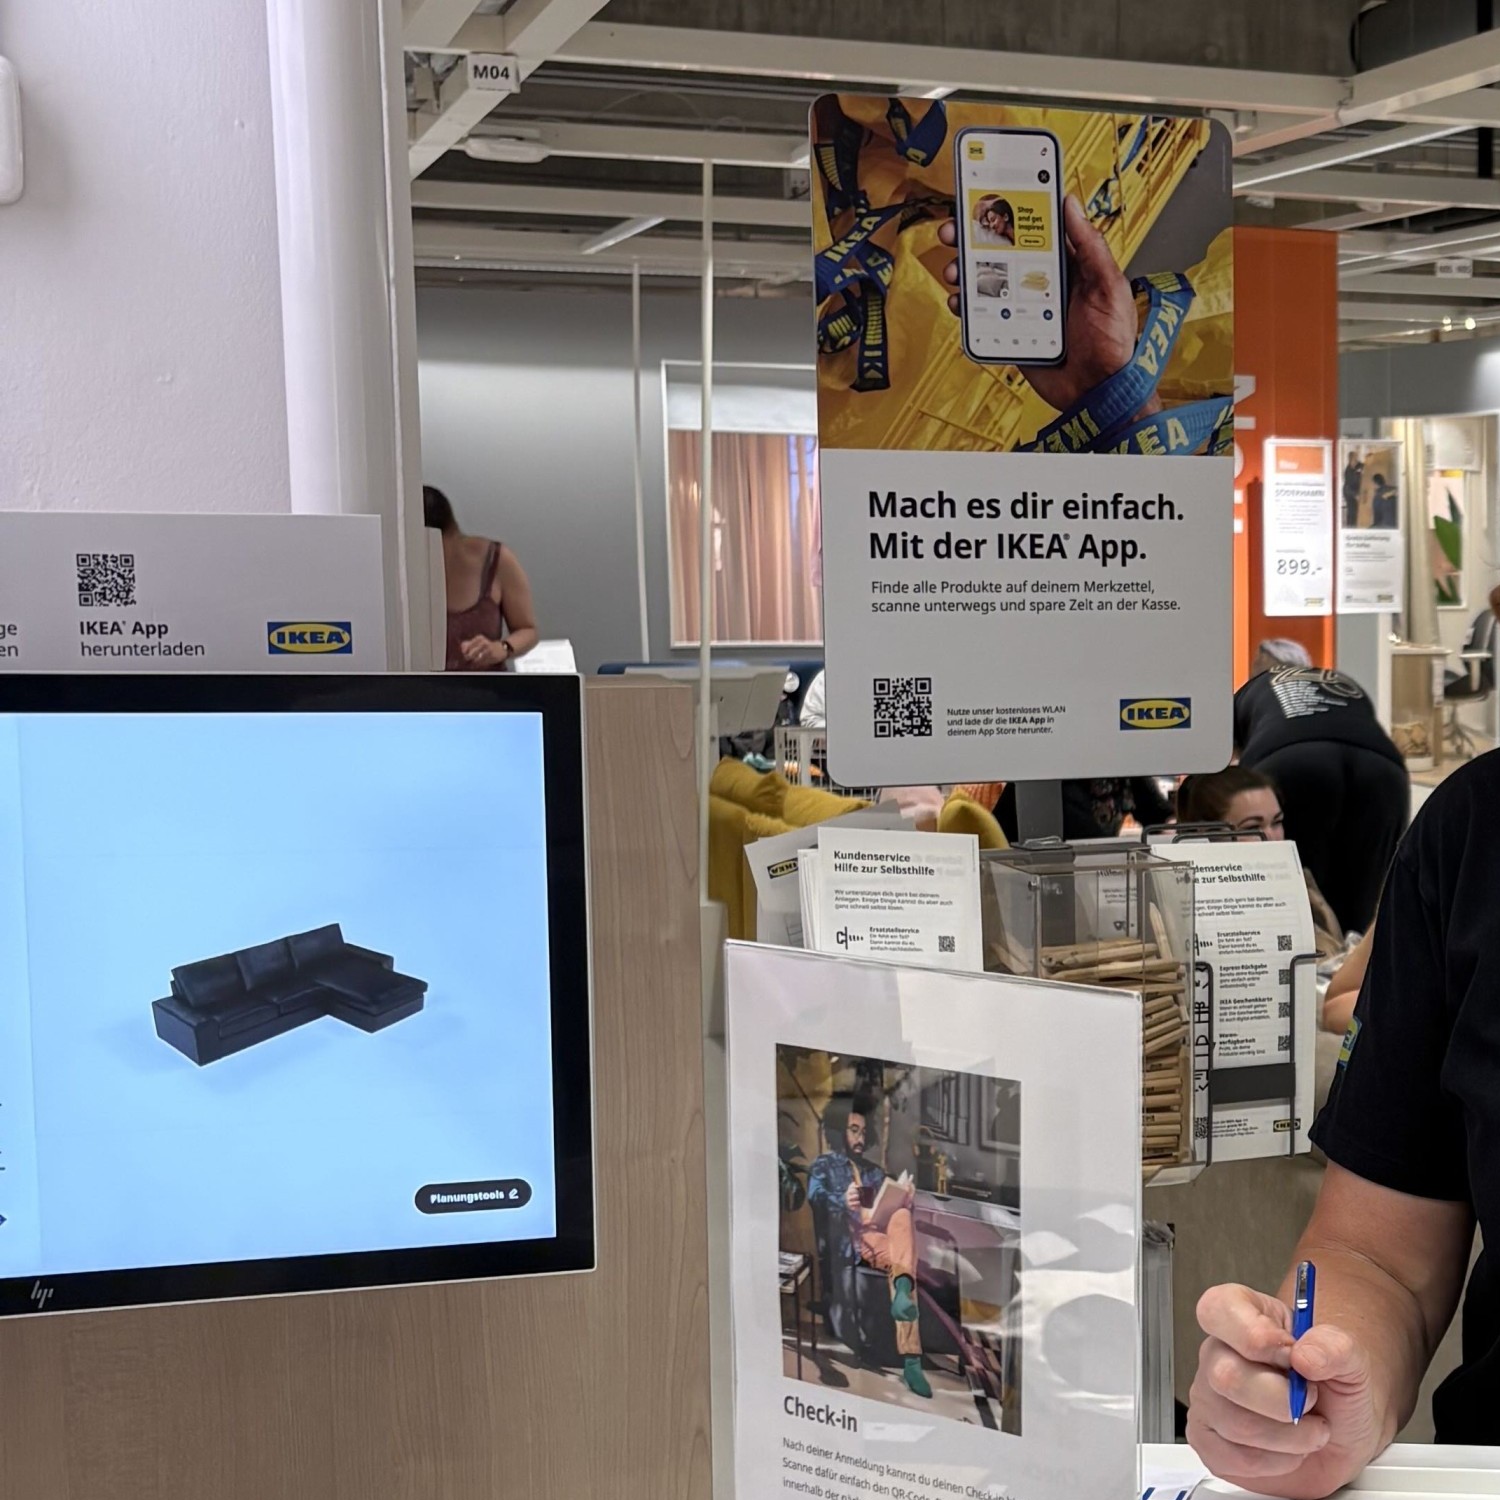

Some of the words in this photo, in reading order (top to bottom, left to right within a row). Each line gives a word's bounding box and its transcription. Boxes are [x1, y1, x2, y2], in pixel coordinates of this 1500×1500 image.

[473, 64, 510, 79] M04
[825, 215, 882, 262] IKEA
[1137, 298, 1184, 376] IKEA
[868, 490, 957, 519] Mach
[966, 497, 1001, 519] es
[1010, 491, 1054, 519] dir
[1062, 492, 1184, 521] einfach.
[869, 531, 925, 559] Mit
[933, 531, 988, 559] der
[1078, 533, 1147, 568] App.
[1276, 558, 1323, 576] 899.-
[871, 580, 910, 594] Finde
[912, 580, 937, 594] alle
[941, 580, 1002, 594] Produkte
[1006, 579, 1028, 593] auf
[1031, 580, 1080, 593] deinem
[1084, 579, 1155, 595] Merkzettel,
[871, 601, 921, 612] scanne
[924, 600, 997, 615] unterwegs
[1000, 599, 1026, 612] und
[1029, 600, 1066, 615] spare
[1069, 598, 1094, 611] Zeit
[1097, 601, 1113, 611] an
[1116, 598, 1138, 611] der
[1141, 598, 1181, 611] Kasse.
[131, 621, 169, 639] App
[276, 630, 347, 645] IKEA
[80, 642, 206, 656] herunterladen
[947, 708, 970, 716] Nutze
[972, 708, 994, 716] unser
[996, 706, 1041, 715] kostenloses
[1042, 705, 1066, 714] WLAN
[1127, 706, 1186, 720] IKEA
[947, 718, 963, 726] und
[965, 717, 981, 726] lade
[983, 717, 993, 725] dir
[995, 716, 1007, 725] die
[1009, 716, 1028, 725] IKEA
[1029, 716, 1046, 726] App
[1047, 715, 1055, 723] in
[947, 727, 977, 737] deinem
[978, 727, 995, 737] App
[996, 727, 1017, 736] Store
[1018, 726, 1053, 735] herunter.
[833, 850, 911, 863] Kundenservice
[834, 863, 859, 875] Hilfe
[861, 865, 878, 875] zur
[880, 864, 935, 877] Selbsthilfe
[1201, 875, 1216, 884] zur
[1218, 874, 1266, 884] Selbsthilfe
[429, 1190, 505, 1205] Planungstools
[783, 1395, 858, 1433] Check-in
[782, 1437, 805, 1453] Nach
[806, 1444, 833, 1460] deiner
[834, 1451, 885, 1477] Anmeldung
[886, 1464, 916, 1483] kannst
[918, 1474, 931, 1486] du
[932, 1477, 964, 1495] deinen
[782, 1457, 813, 1475] Scanne
[815, 1466, 838, 1481] dafür
[839, 1474, 871, 1491] einfach
[872, 1482, 890, 1496] den
[782, 1476, 824, 1497] innerhalb
[824, 1488, 840, 1500] der
